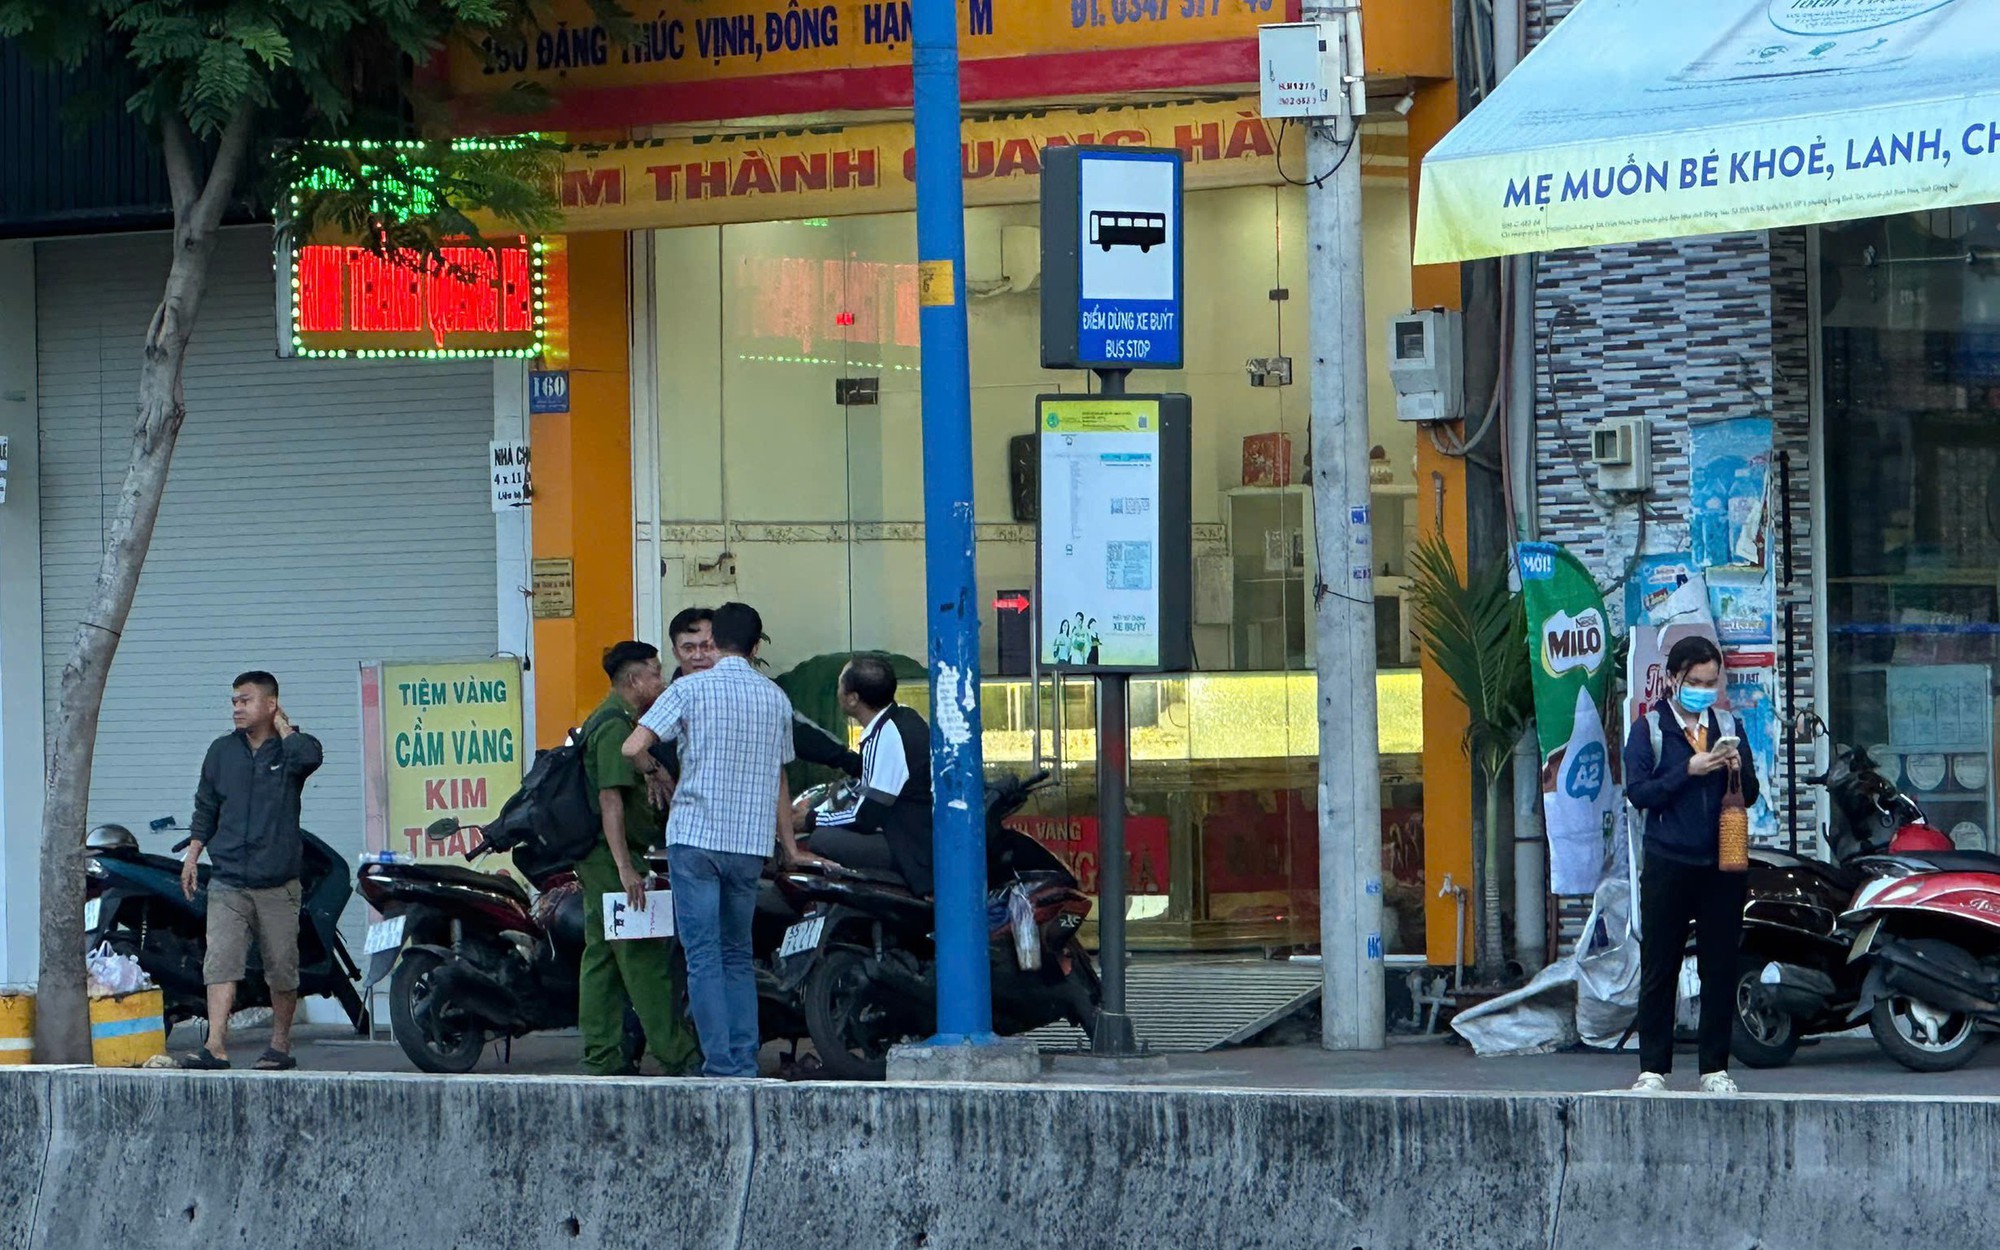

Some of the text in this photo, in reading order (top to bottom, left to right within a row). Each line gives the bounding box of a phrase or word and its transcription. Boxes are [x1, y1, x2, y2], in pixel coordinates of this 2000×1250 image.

[616, 10, 684, 64] HÚC
[645, 150, 876, 201] THÀNH
[1503, 173, 1554, 212] MẸ
[1679, 148, 1719, 190] BÉ
[1845, 128, 1951, 172] LANH,
[1136, 312, 1149, 330] XE
[1105, 339, 1151, 358] BUS STOP
[533, 376, 567, 397] 160
[1548, 627, 1601, 660] MILO
[399, 675, 507, 713] TIỆM VÀNG
[395, 716, 513, 768] CẦM VÀNG
[425, 777, 487, 811] KIM
